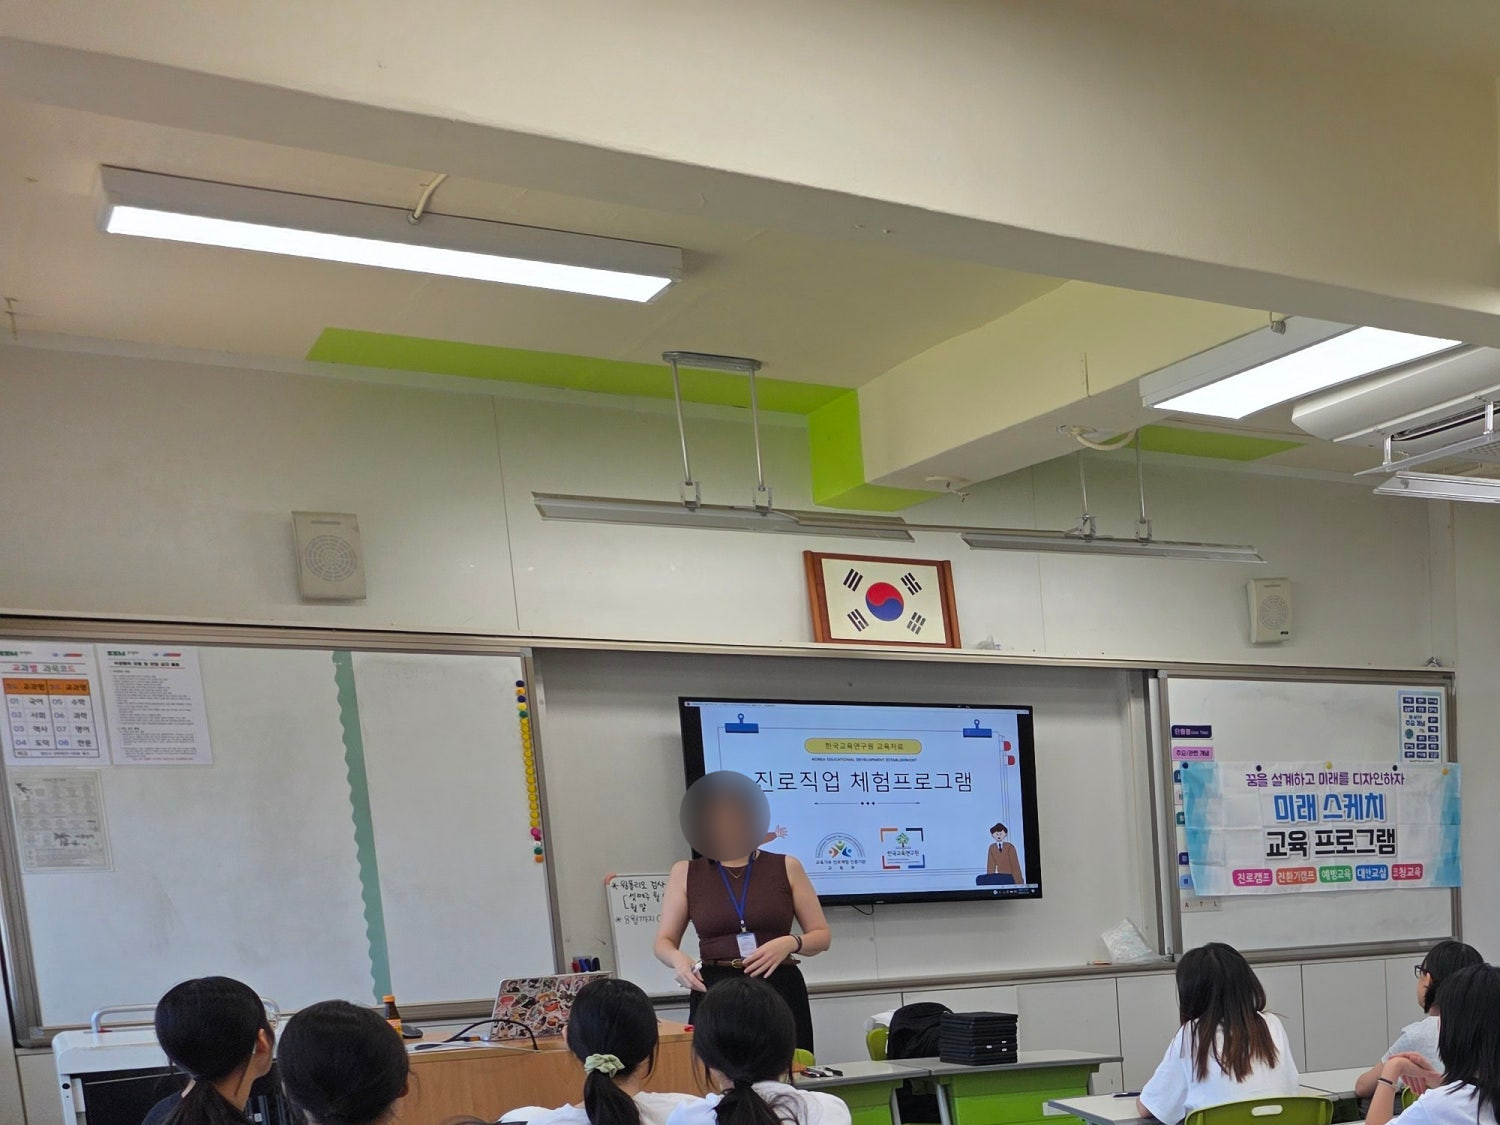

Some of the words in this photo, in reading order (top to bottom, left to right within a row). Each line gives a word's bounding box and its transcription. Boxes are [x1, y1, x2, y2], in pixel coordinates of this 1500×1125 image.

[12, 664, 38, 673] 교과별
[825, 742, 874, 750] 한국교육연구원
[877, 742, 904, 750] 교육자료
[755, 770, 840, 793] 진로직업
[850, 770, 972, 793] 체험프로그램
[1246, 773, 1268, 787] 꿈을
[1271, 773, 1315, 787] 설계하고
[1318, 772, 1350, 786] 미래를
[1353, 772, 1405, 786] 디자인하자
[1274, 793, 1317, 822] 미래
[1323, 792, 1385, 821] 스케치
[1266, 830, 1308, 858] 교육
[1314, 828, 1396, 855] 프로그램
[1236, 872, 1271, 883] 진로캠프
